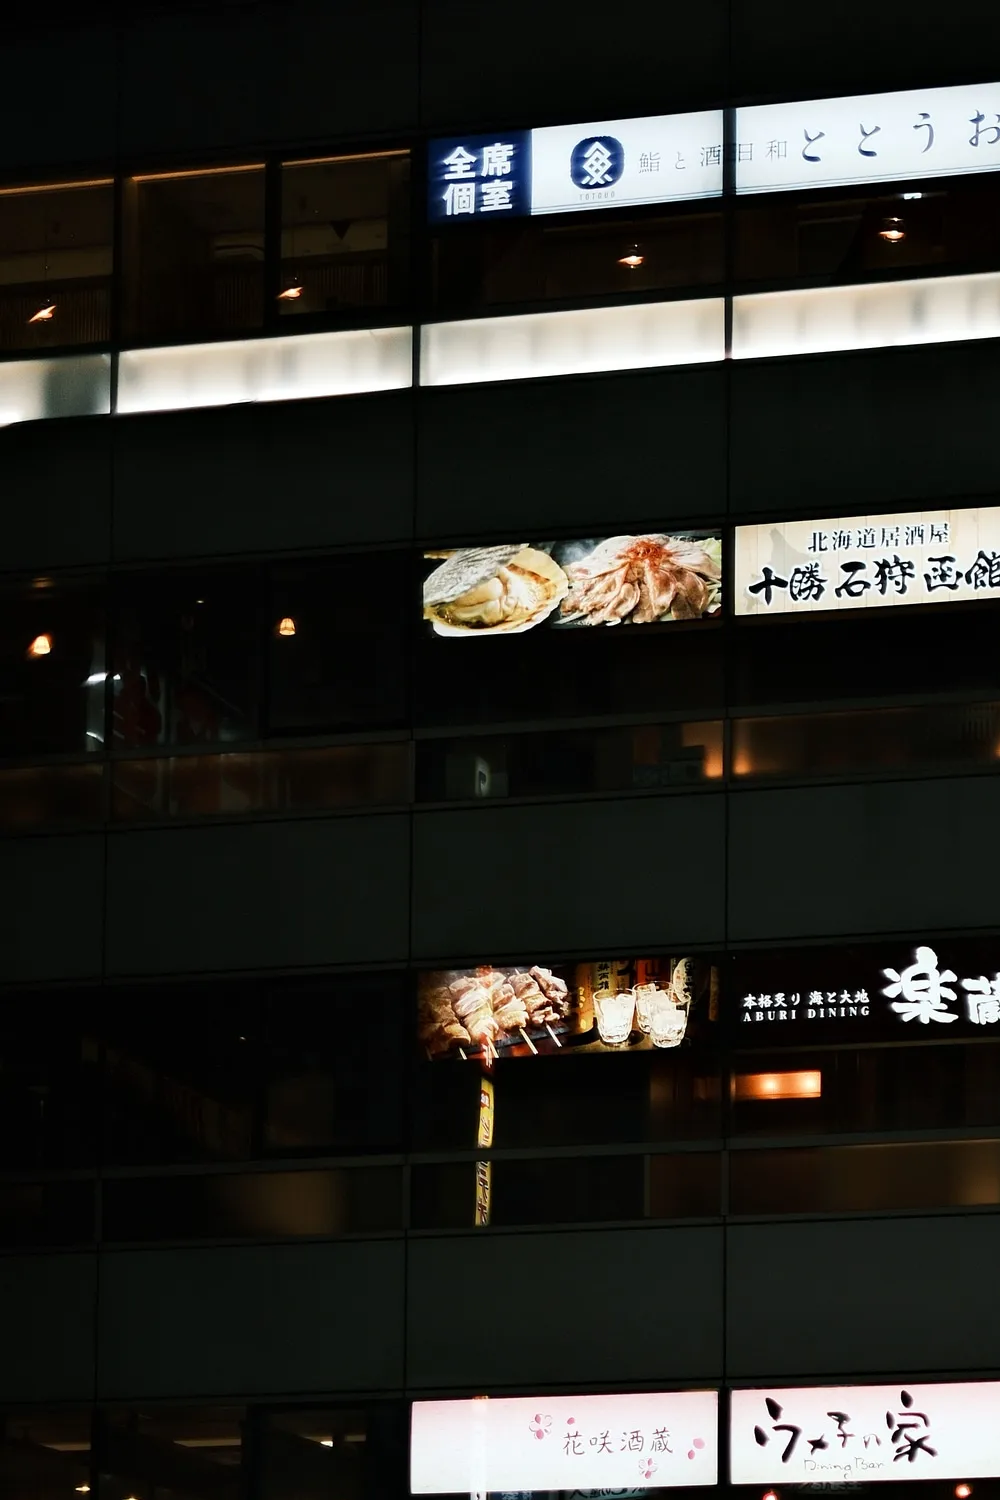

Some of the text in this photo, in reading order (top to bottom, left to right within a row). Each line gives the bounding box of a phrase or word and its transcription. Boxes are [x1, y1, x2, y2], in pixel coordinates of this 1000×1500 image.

[443, 141, 514, 180] 全席
[442, 181, 514, 216] 個室
[808, 522, 950, 553] 北海道居酒屋
[743, 1006, 871, 1022] ABURI DINING
[562, 1427, 675, 1457] 花咲酒蔵
